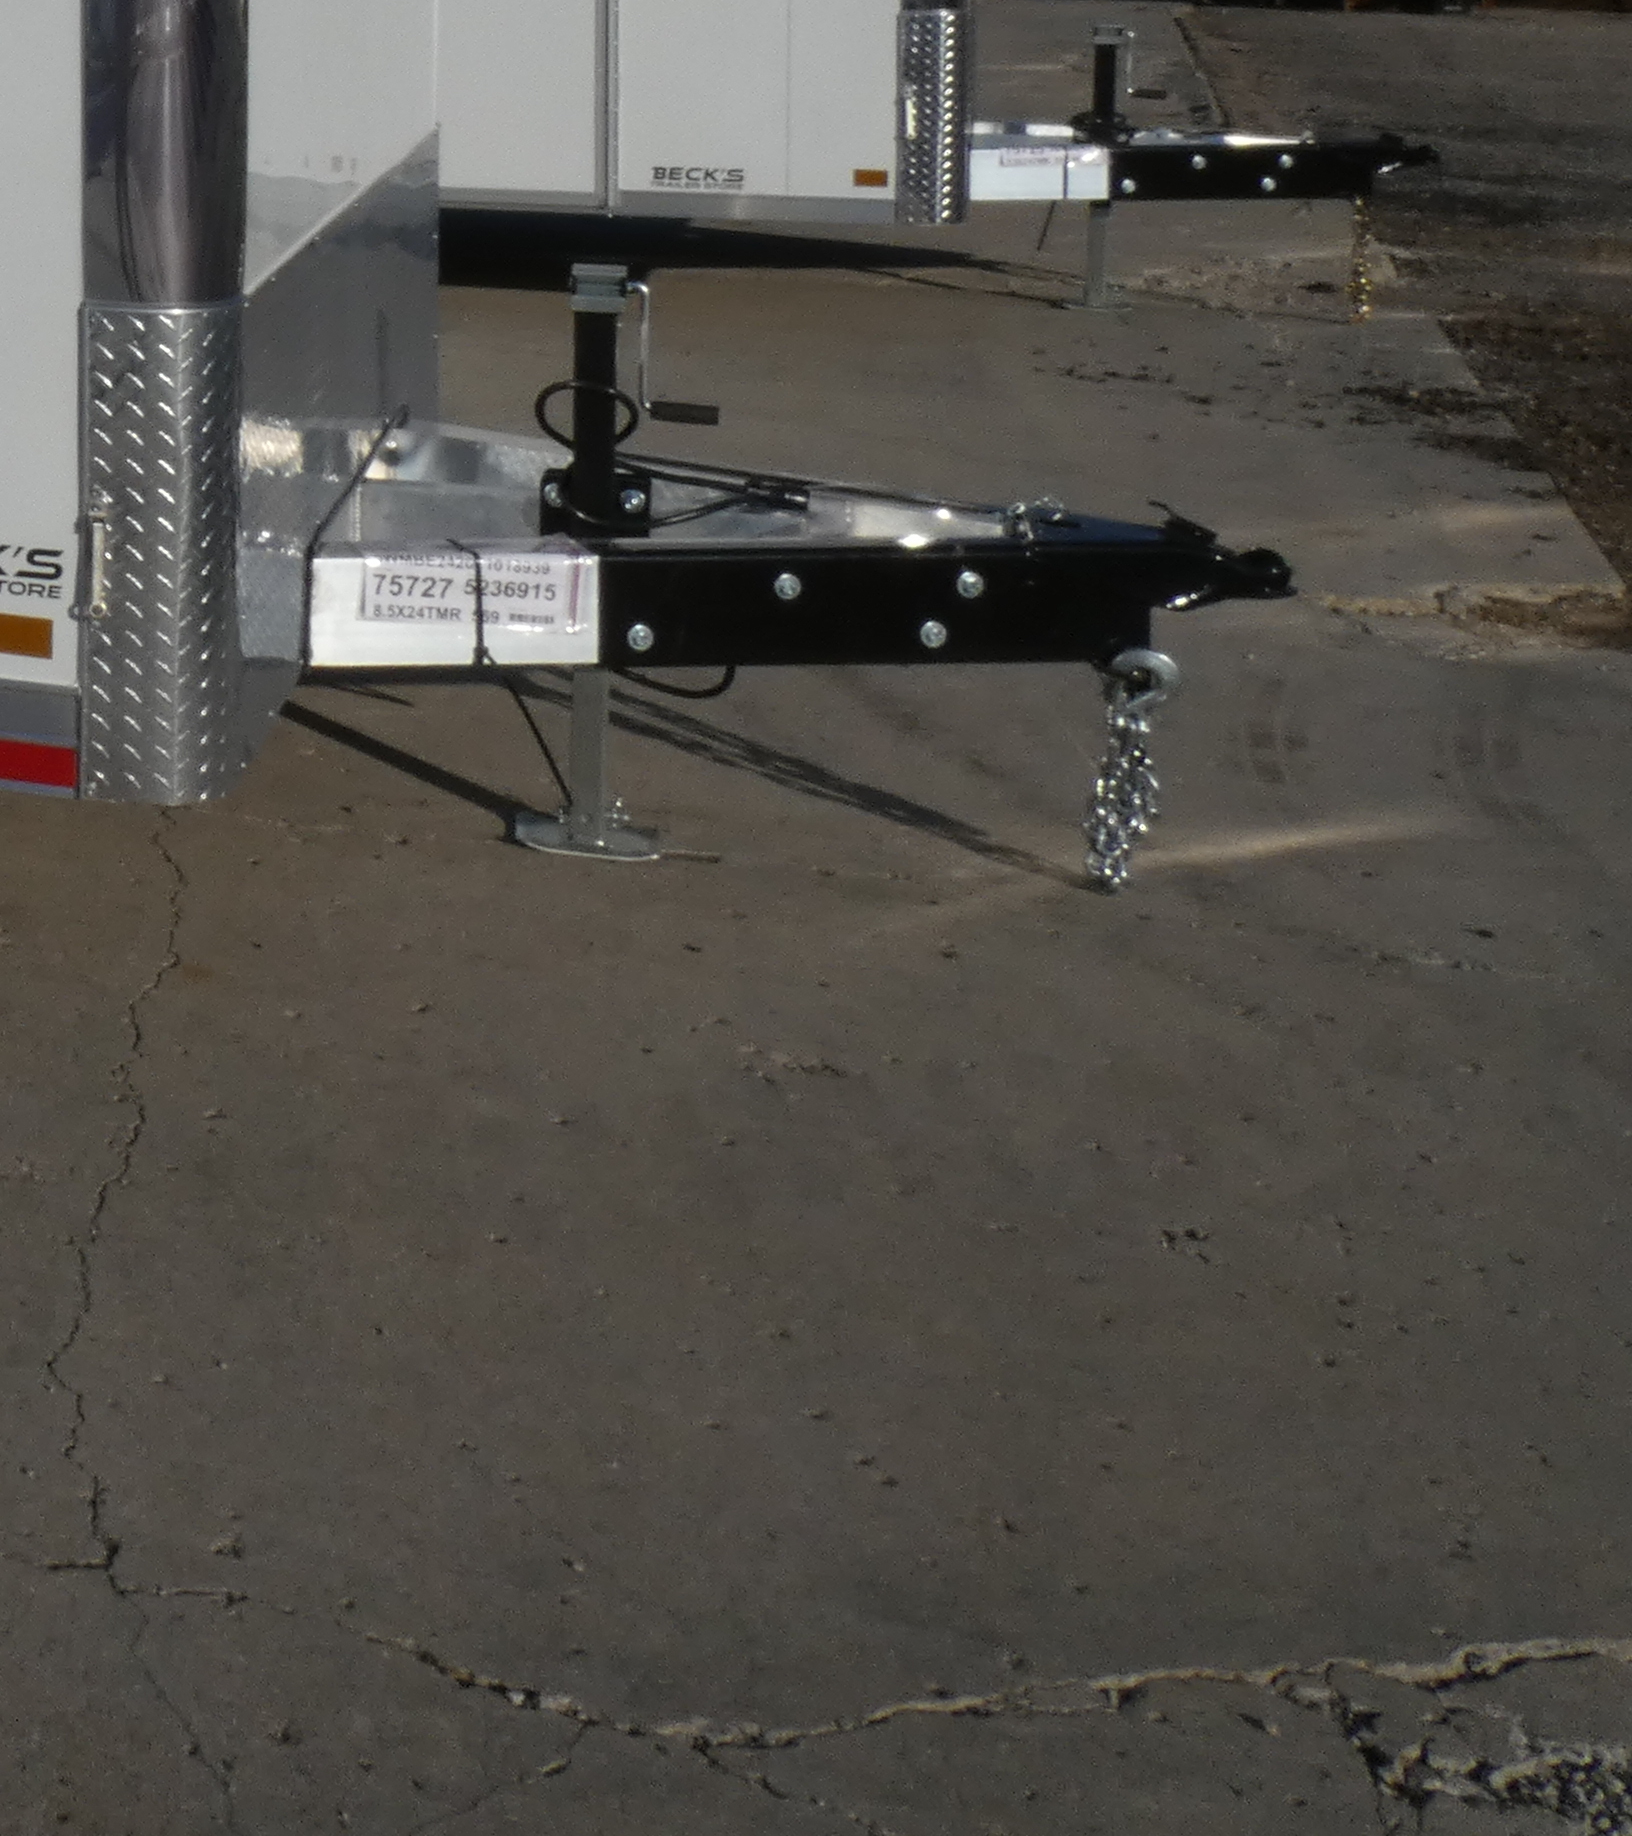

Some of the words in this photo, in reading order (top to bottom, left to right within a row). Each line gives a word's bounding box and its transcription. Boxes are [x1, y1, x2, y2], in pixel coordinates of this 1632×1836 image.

[651, 166, 744, 182] BECK'S
[373, 574, 454, 599] 75727
[463, 577, 557, 602] 5236915
[373, 604, 461, 621] 8.5X24TMR
